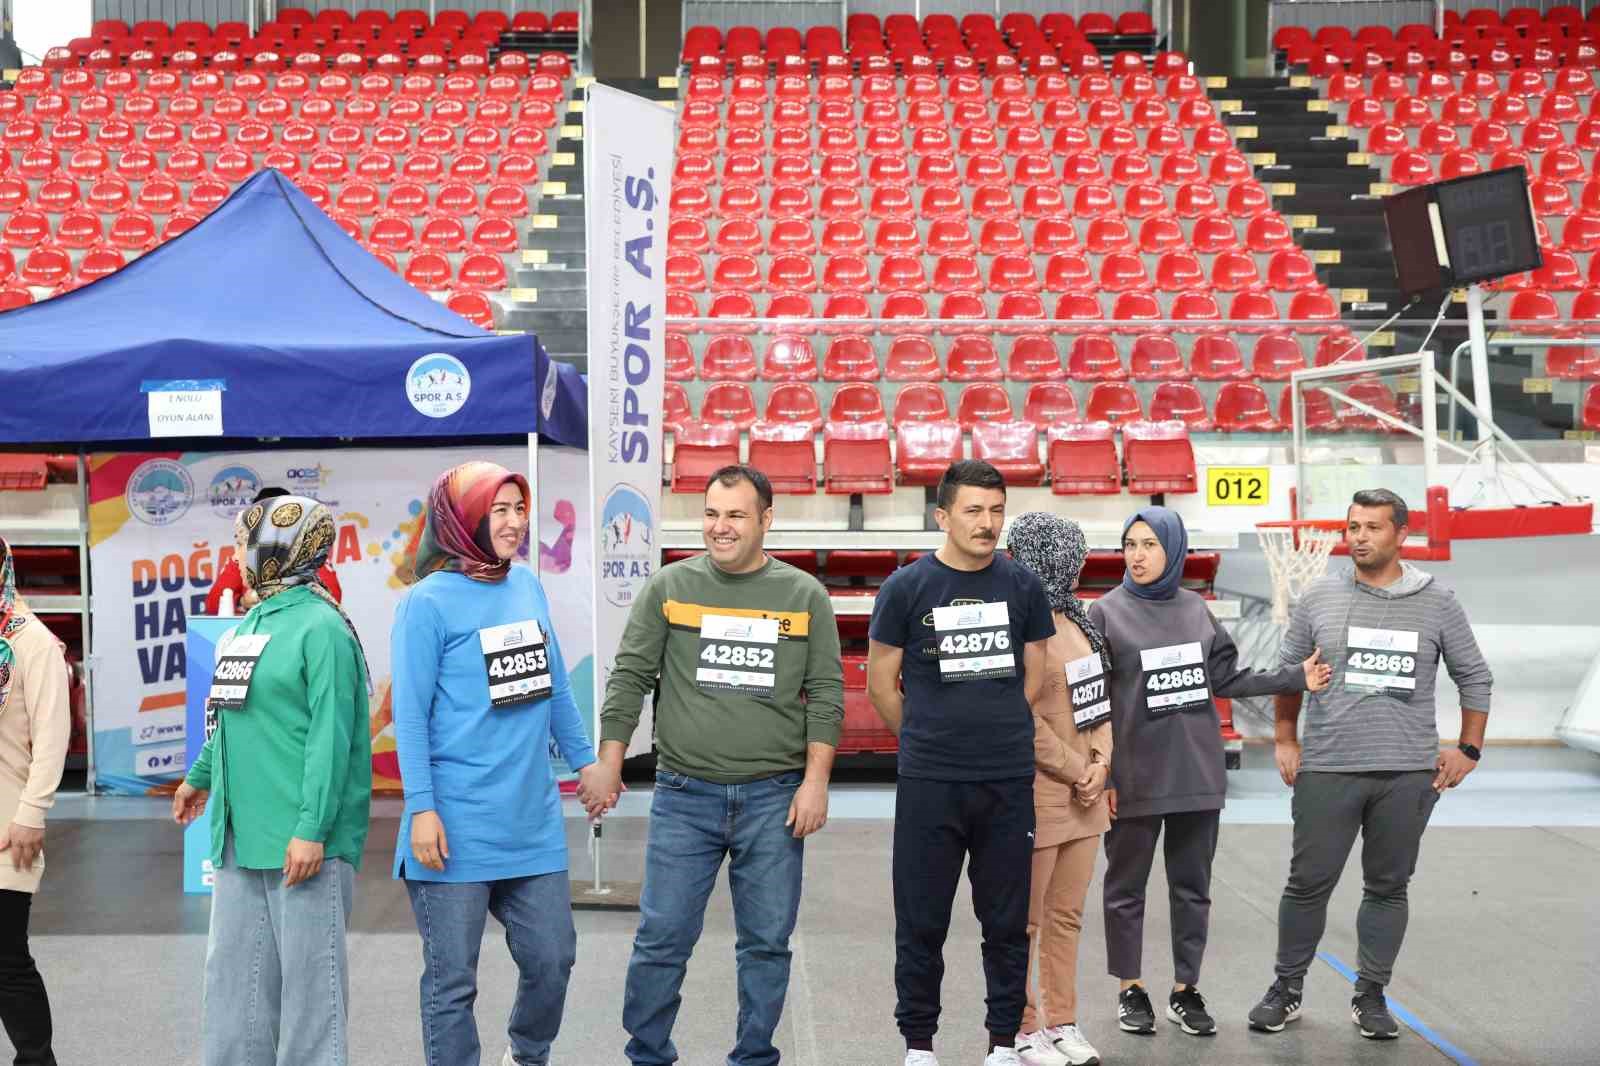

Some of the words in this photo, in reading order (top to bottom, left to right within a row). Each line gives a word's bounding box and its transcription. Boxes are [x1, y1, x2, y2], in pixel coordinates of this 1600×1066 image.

[625, 166, 658, 279] A.Ş.
[621, 301, 651, 463] SPOR
[414, 392, 441, 402] SPOR
[211, 495, 235, 506] SPOR
[1216, 477, 1262, 500] 012
[602, 560, 625, 578] SPOR
[940, 630, 1010, 655] 42876
[489, 648, 547, 679] 42853
[700, 643, 775, 669] 42852
[1347, 652, 1415, 673] 42869
[214, 660, 256, 681] 42866
[1146, 667, 1206, 692] 42868
[1072, 678, 1105, 706] 42877
